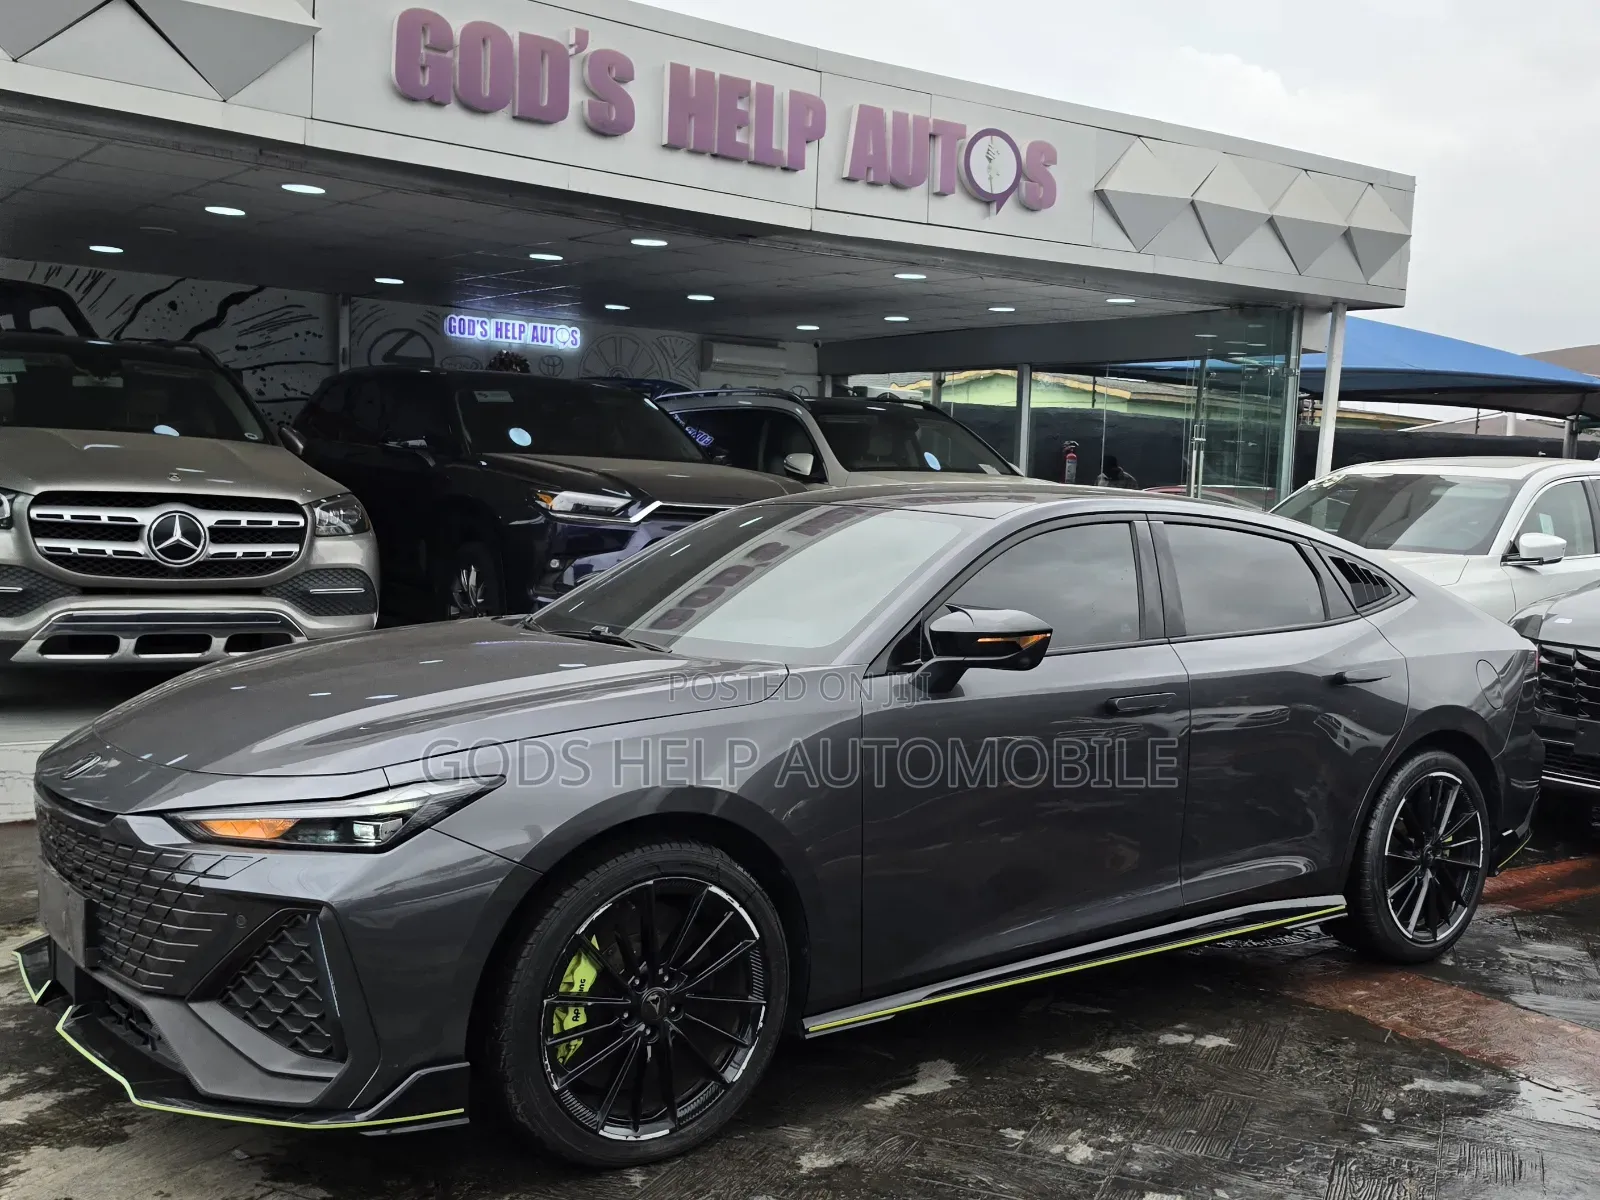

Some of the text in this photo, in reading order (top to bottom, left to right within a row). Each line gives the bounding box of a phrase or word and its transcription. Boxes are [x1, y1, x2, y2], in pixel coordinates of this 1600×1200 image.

[392, 7, 1059, 215] GOD'S HELP AUTOS
[447, 316, 578, 347] GOD'S HELP AUTOS
